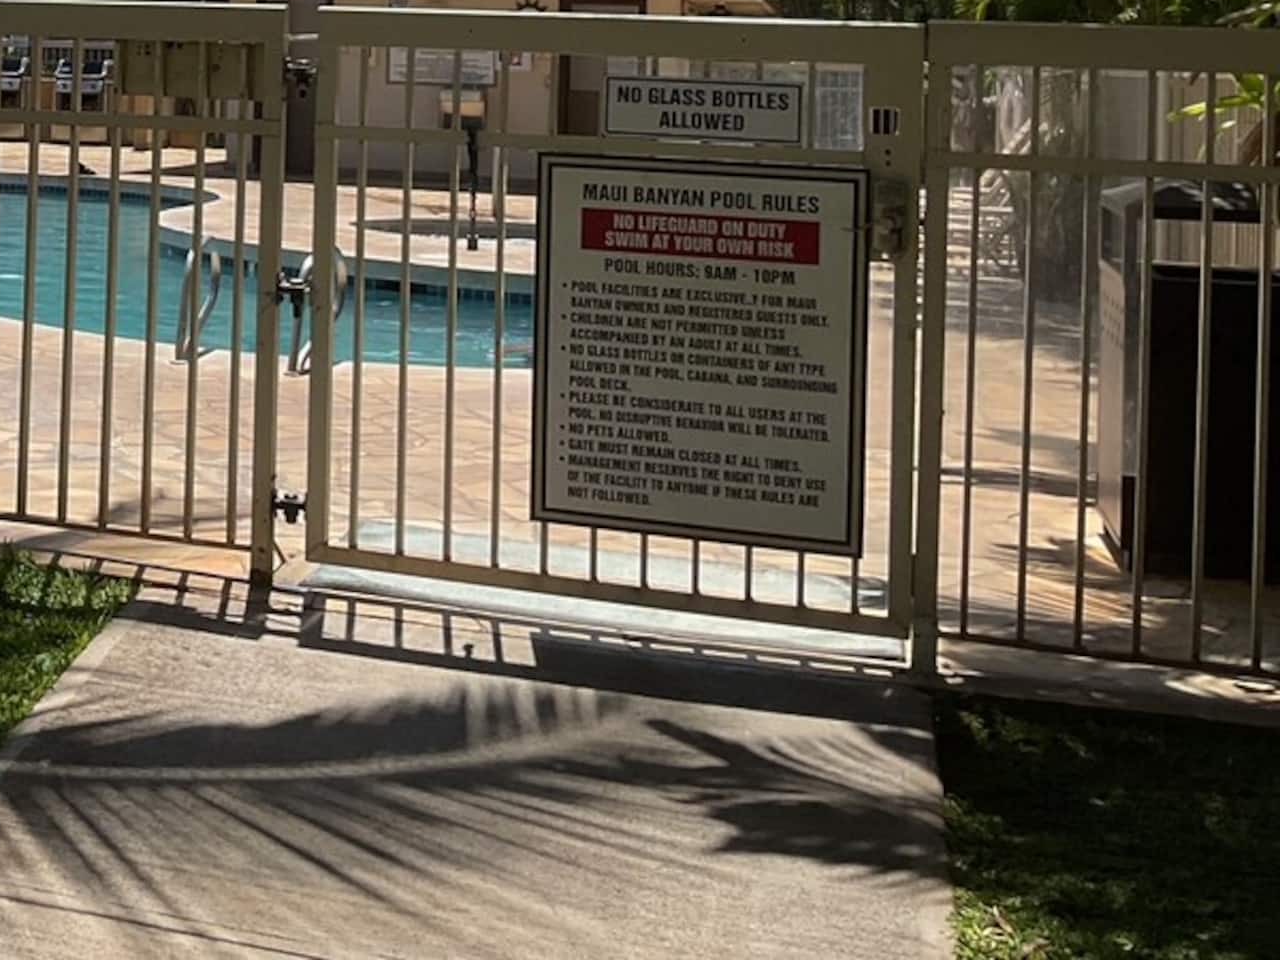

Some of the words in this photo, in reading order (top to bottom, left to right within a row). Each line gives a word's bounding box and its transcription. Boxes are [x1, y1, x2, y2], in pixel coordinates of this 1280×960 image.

[617, 86, 641, 103] NO
[648, 87, 705, 107] GLASS
[712, 90, 789, 110] BOTTLES
[659, 111, 744, 131] ALLOWED
[582, 182, 627, 203] MAUI
[633, 185, 704, 208] BANYAN
[710, 189, 756, 211] POOL
[761, 192, 819, 214] RULES
[613, 212, 634, 230] NO
[637, 214, 718, 235] LIFEGUARD
[721, 219, 743, 237] ON
[747, 220, 785, 240] DUTY
[604, 230, 648, 249] SWIM
[652, 233, 669, 250] AT
[673, 234, 713, 253] YOUR
[716, 237, 754, 256] OWN
[757, 239, 793, 258] RISK
[604, 257, 640, 274] POOL
[645, 260, 699, 278] HOURS:
[704, 264, 736, 281] 9AM
[754, 268, 795, 285] 10PM
[571, 280, 597, 294] POOL
[601, 282, 658, 298] FACILITIES
[661, 286, 681, 300] ARE
[761, 293, 783, 307] FOR
[786, 295, 817, 310] MAUI
[570, 296, 612, 311] BANYAN
[663, 303, 685, 317] AND
[688, 305, 752, 322] REGISTERED
[755, 310, 797, 325] GUESTS
[570, 311, 623, 327] CHILDREN
[626, 316, 646, 329] ARE
[650, 318, 671, 331] NOT
[675, 319, 738, 337] PERMITTED
[740, 325, 785, 340] UNLESS
[570, 327, 648, 345] ACCOMPANIED
[652, 334, 665, 347] BY
[669, 335, 685, 348] AN
[688, 337, 721, 351] ADULT
[725, 340, 737, 353] AT
[741, 341, 760, 355] ALL
[569, 343, 584, 356] NO
[586, 344, 619, 359] GLASS
[623, 347, 667, 363] BOTTLES
[670, 351, 684, 364] OR
[687, 352, 754, 370] CONTAINERS
[757, 358, 770, 372] OF
[774, 360, 795, 374] ANY
[799, 362, 824, 376] TYPE
[569, 358, 616, 375] ALLOWED
[619, 363, 630, 376] IN
[633, 364, 650, 378] THE
[735, 373, 757, 387] AND
[569, 374, 595, 389] POOL
[599, 377, 631, 392] DECK.
[568, 390, 608, 405] PLEASE
[612, 394, 625, 407] BE
[629, 396, 704, 414] CONSIDERATE
[708, 403, 722, 416] TO
[725, 404, 743, 418] ALL
[748, 406, 785, 422] USERS
[788, 410, 802, 424] AT
[806, 412, 826, 426] THE
[599, 408, 612, 422] NO
[615, 410, 671, 428] DISRUPTIVE
[675, 416, 724, 433] BEHAVIOR
[727, 421, 750, 435] WILL
[754, 423, 767, 437] BE
[568, 421, 584, 435] NO
[586, 423, 613, 438] PETS
[616, 426, 671, 443] ALLOWED.
[568, 437, 593, 452] GATE
[597, 440, 627, 455] MUST
[631, 443, 675, 460] REMAIN
[678, 448, 721, 465] CLOSED
[724, 453, 736, 466] AT
[740, 454, 759, 469] ALL
[568, 453, 640, 472] MANAGEMENT
[644, 461, 697, 478] RESERVES
[701, 467, 719, 481] THE
[723, 469, 754, 484] RIGHT
[757, 473, 770, 486] TO
[773, 474, 802, 489] DENY
[805, 478, 826, 492] USE
[567, 468, 579, 482] OF
[583, 470, 600, 484] THE
[604, 472, 647, 489] FACILITY
[651, 477, 663, 491] TO
[666, 479, 708, 496] ANYONE
[724, 485, 757, 501] THESE
[760, 489, 795, 505] RULES
[797, 493, 819, 508] ARE
[567, 485, 587, 499] NOT
[591, 487, 652, 506] FOLLOWED.
